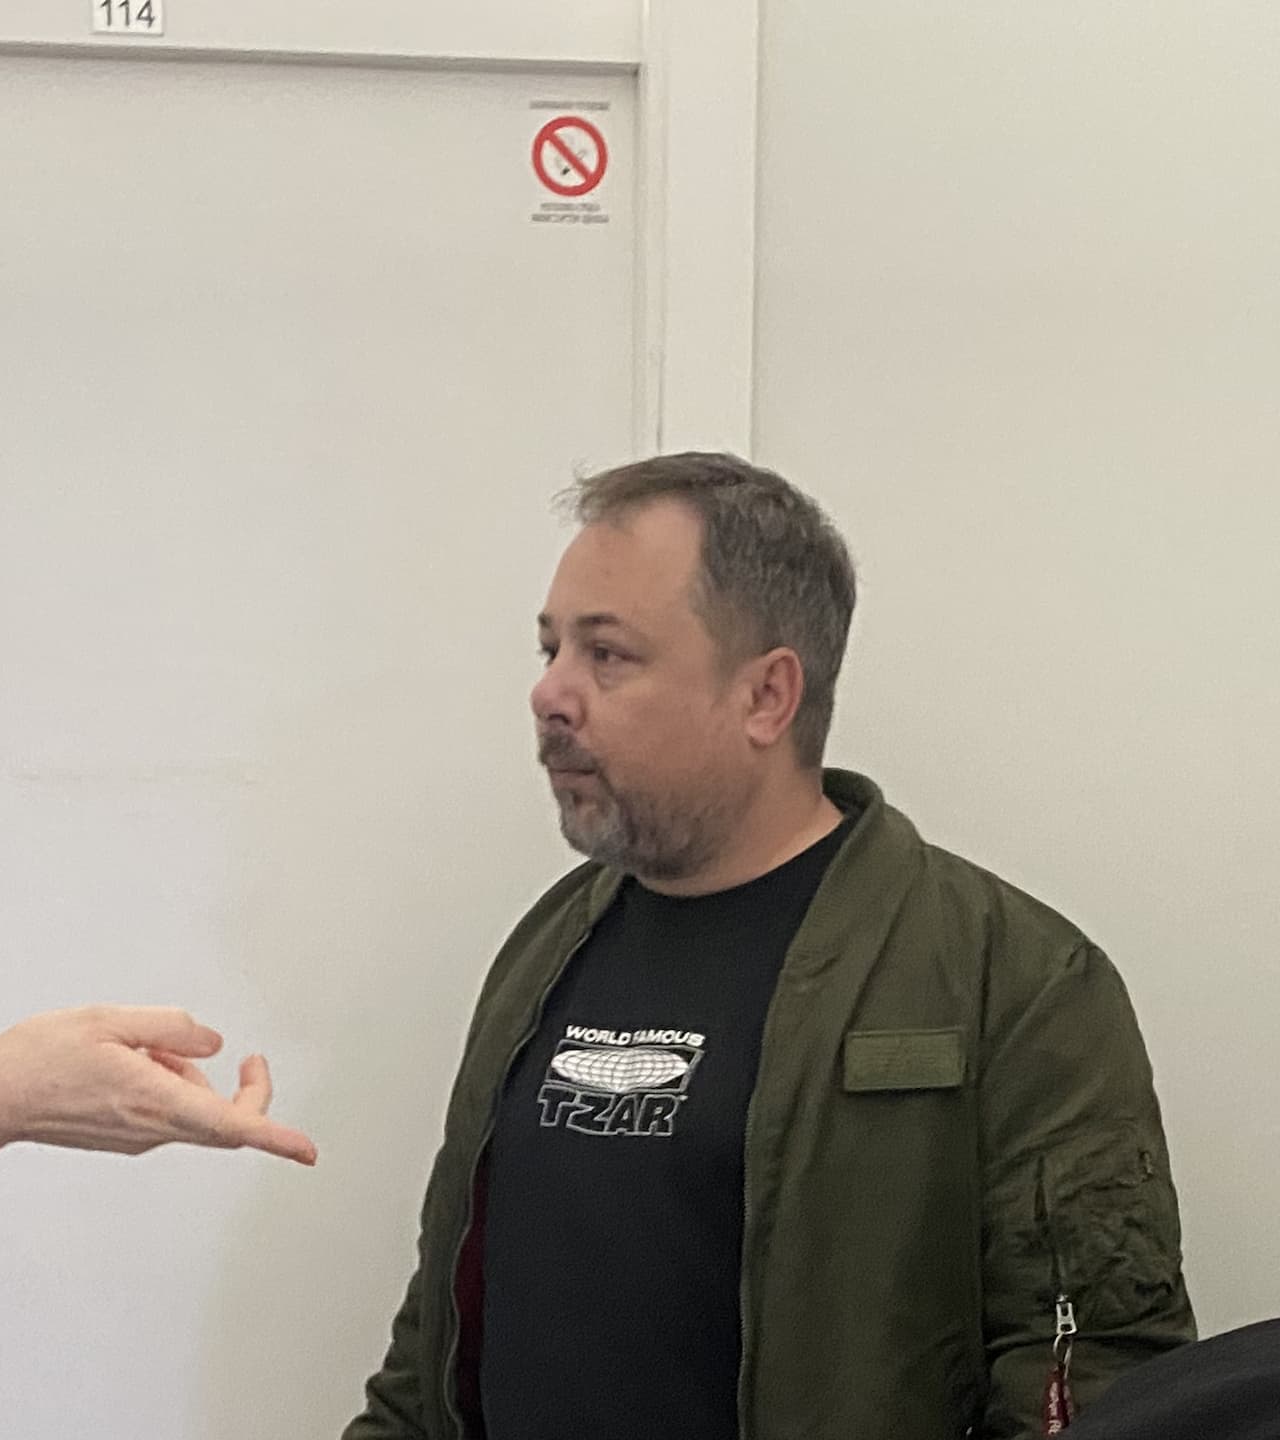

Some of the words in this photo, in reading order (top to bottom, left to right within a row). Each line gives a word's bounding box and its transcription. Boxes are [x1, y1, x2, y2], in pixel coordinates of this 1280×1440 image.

[100, 0, 155, 28] 114
[565, 1024, 632, 1045] WORLD
[632, 1029, 706, 1048] FAMOUS
[537, 1084, 679, 1137] TZAR
